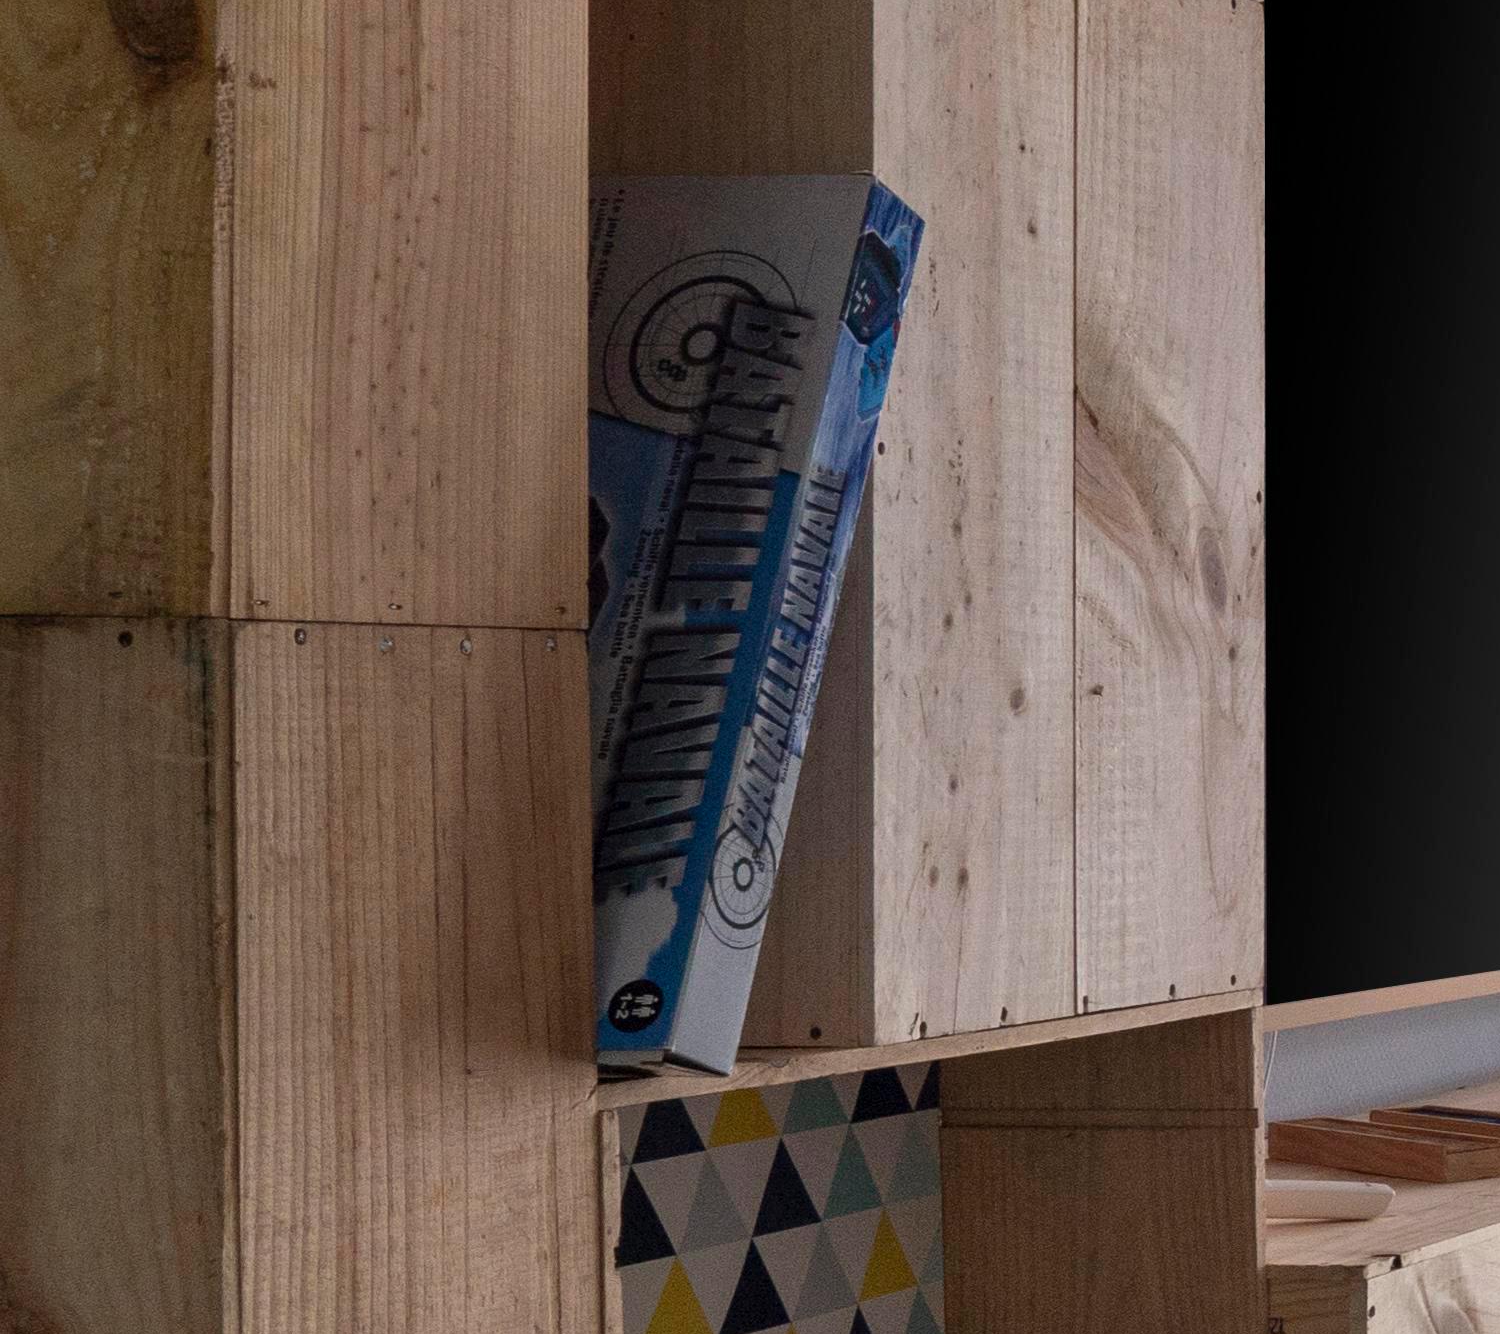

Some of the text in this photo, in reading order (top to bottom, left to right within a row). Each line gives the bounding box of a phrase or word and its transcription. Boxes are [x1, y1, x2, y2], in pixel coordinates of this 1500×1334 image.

[597, 299, 815, 897] BATAILLE NAVALE
[608, 618, 629, 659] battle
[736, 465, 846, 848] BATAILLE NAVALE
